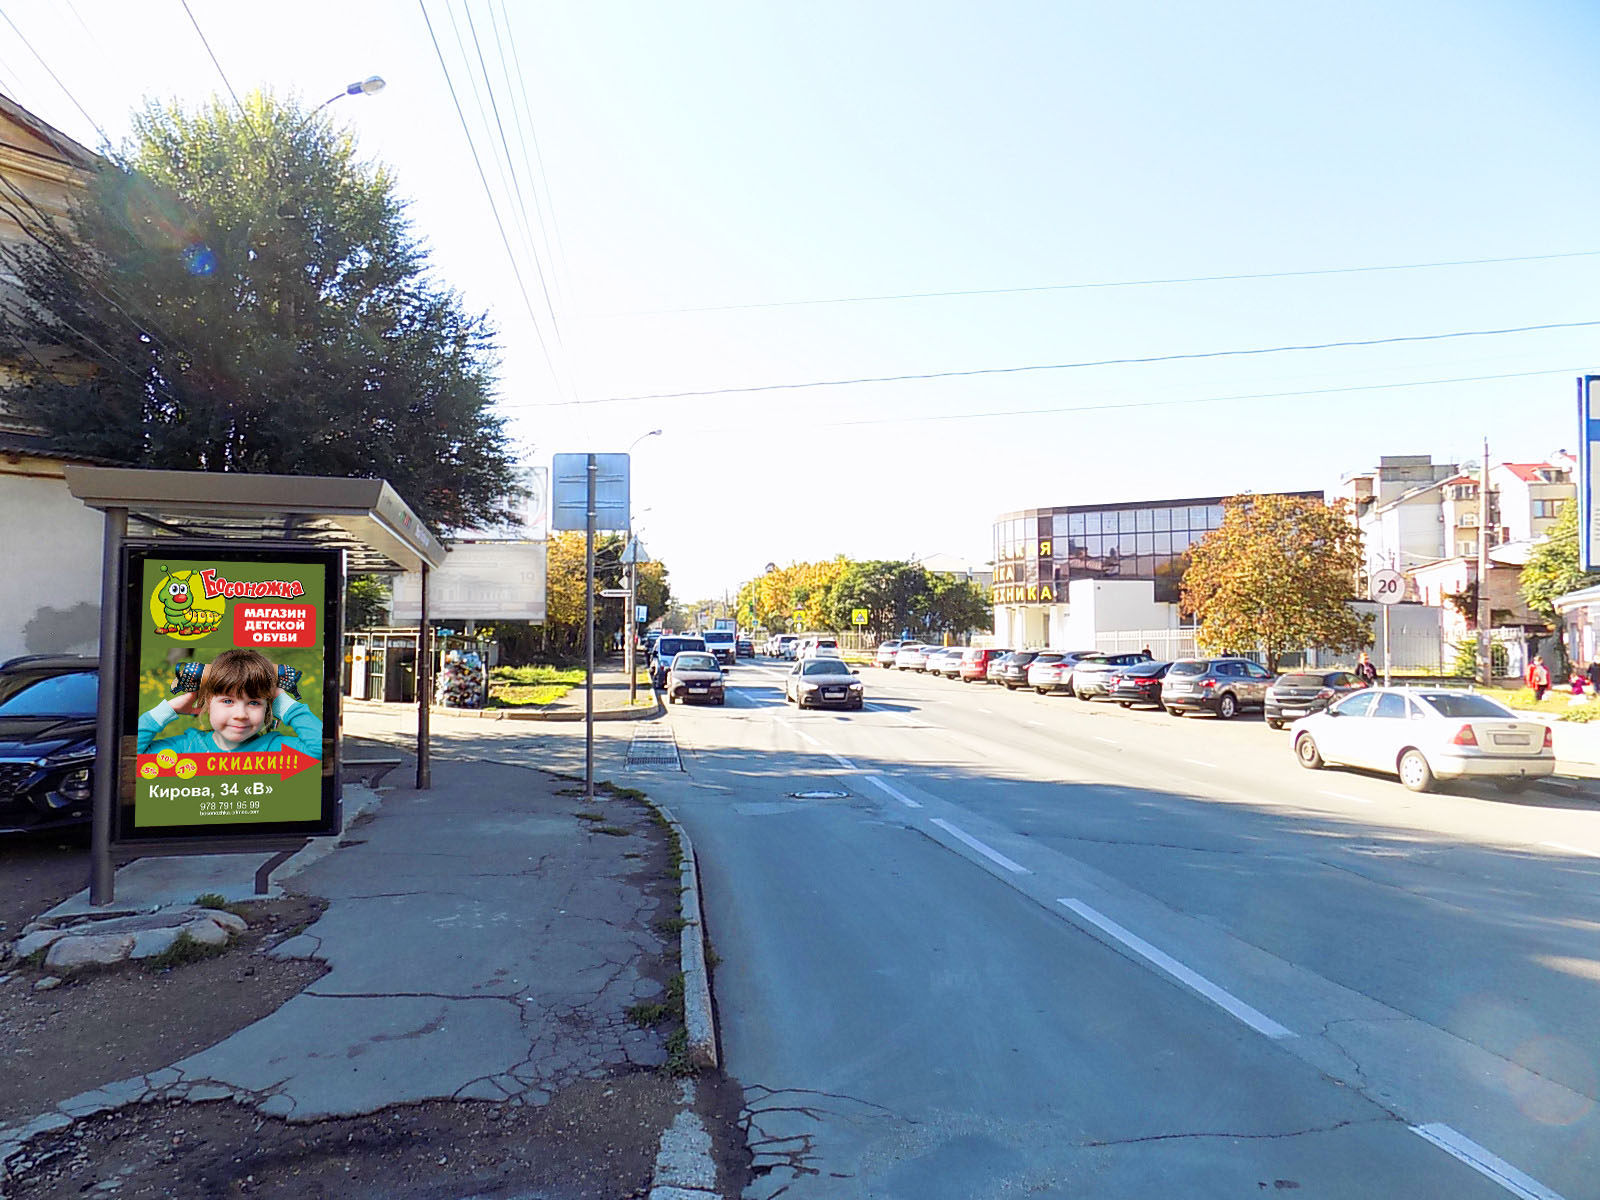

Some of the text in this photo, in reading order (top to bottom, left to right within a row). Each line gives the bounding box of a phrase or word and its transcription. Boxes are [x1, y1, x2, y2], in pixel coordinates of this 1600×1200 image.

[199, 568, 305, 599] Босоножка
[1378, 579, 1397, 593] 20
[244, 608, 306, 618] МАГАЗИН
[244, 619, 305, 631] ДЕТСКОЙ
[252, 633, 297, 642] ОБУВИ
[206, 755, 298, 771] СКИДКИ!!!
[149, 782, 274, 800] Кирова, 34 «В»
[200, 802, 216, 810] 978
[218, 801, 233, 810] 791
